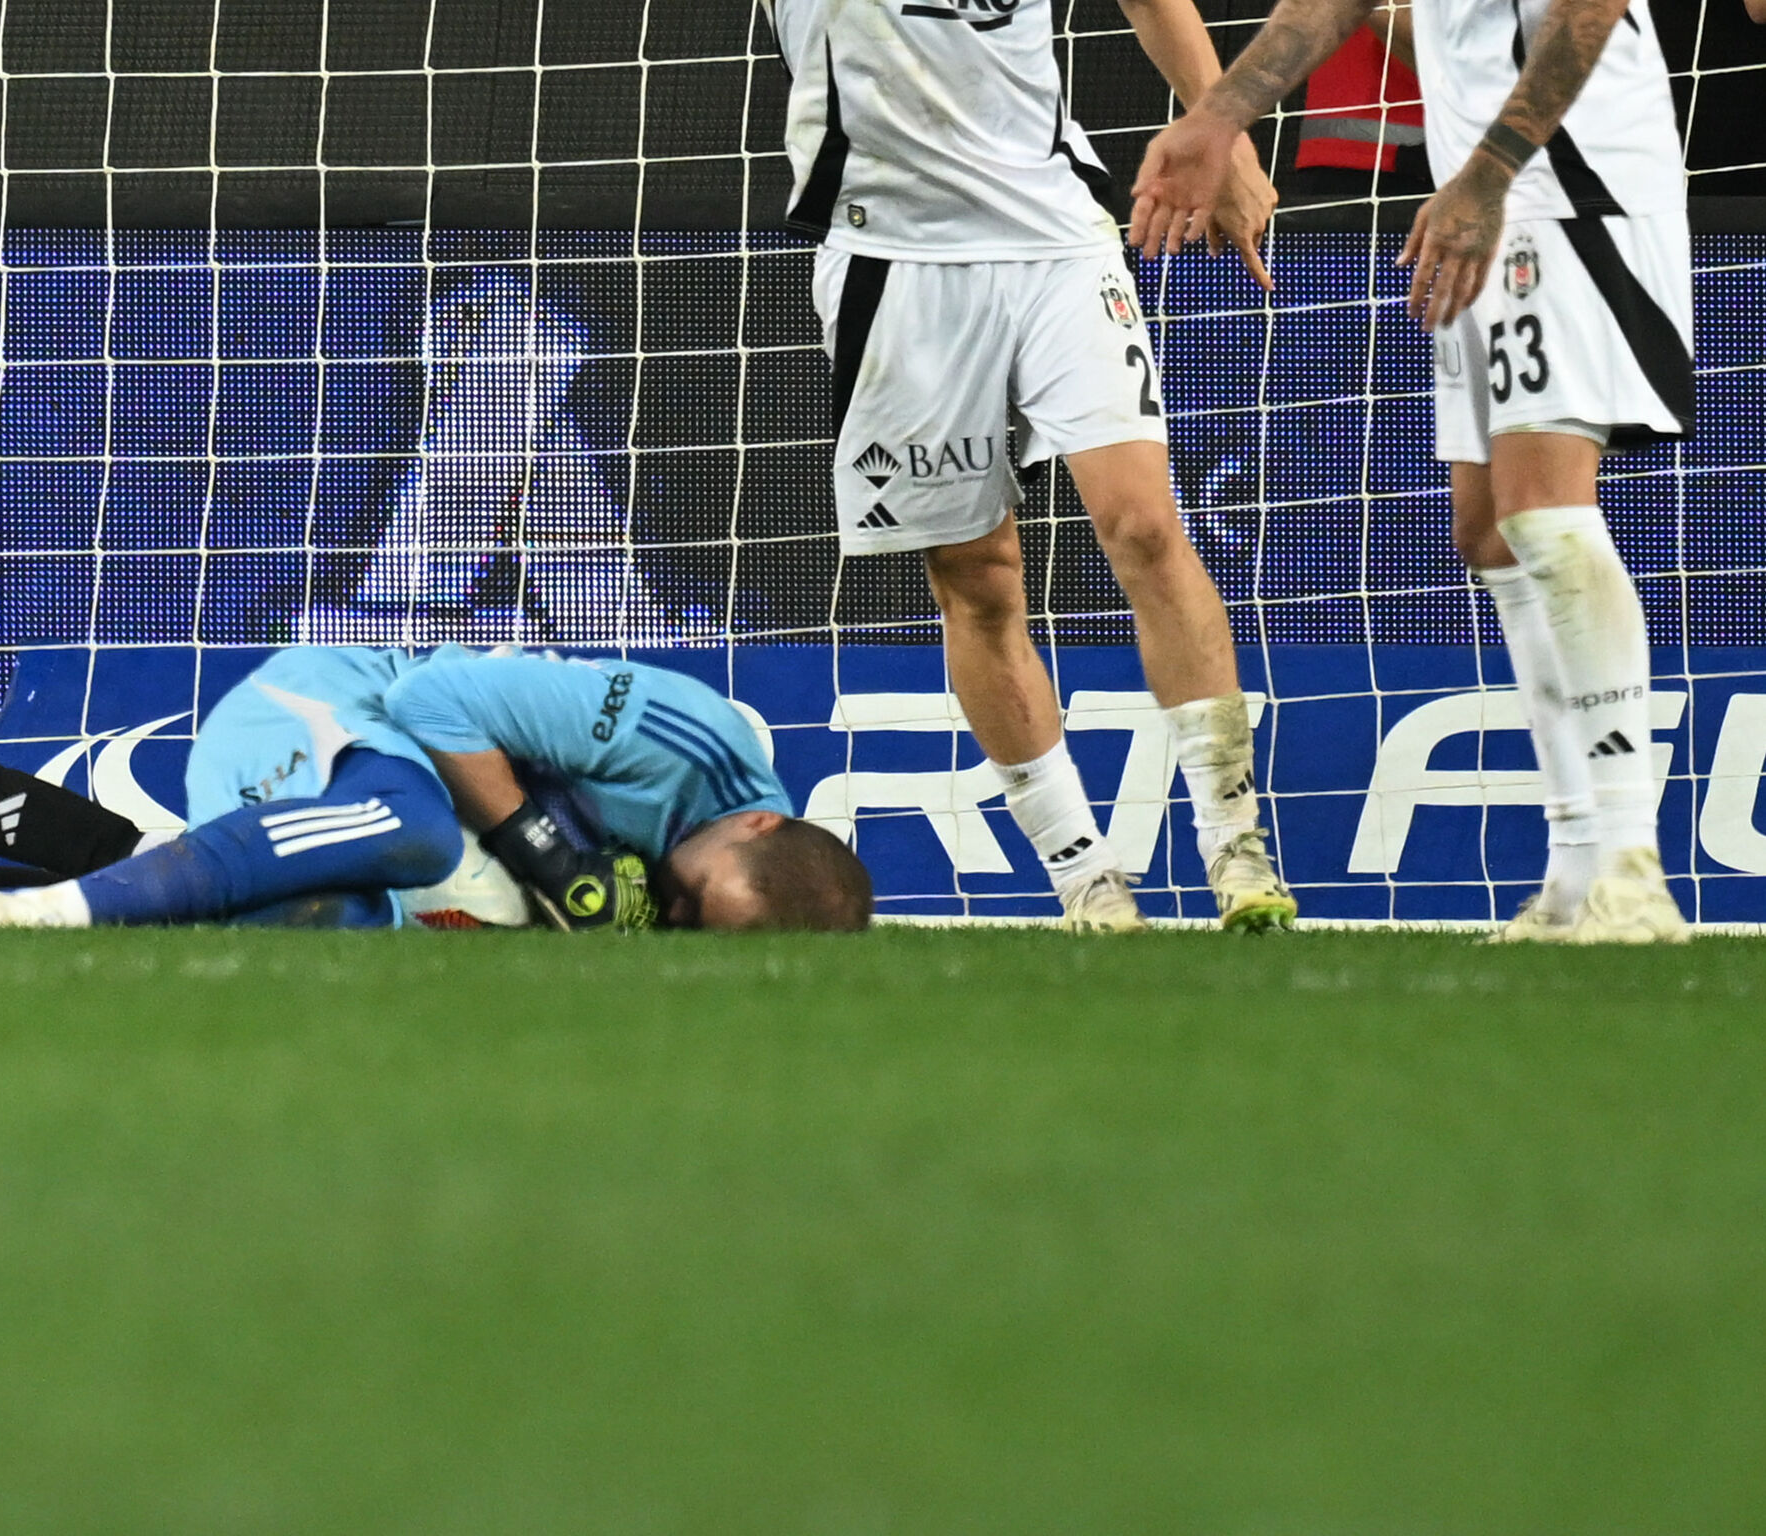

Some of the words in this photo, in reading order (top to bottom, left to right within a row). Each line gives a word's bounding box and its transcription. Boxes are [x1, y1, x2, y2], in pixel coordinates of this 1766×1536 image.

[1124, 343, 1162, 418] 2
[1488, 313, 1551, 404] 53
[906, 436, 994, 478] BAU
